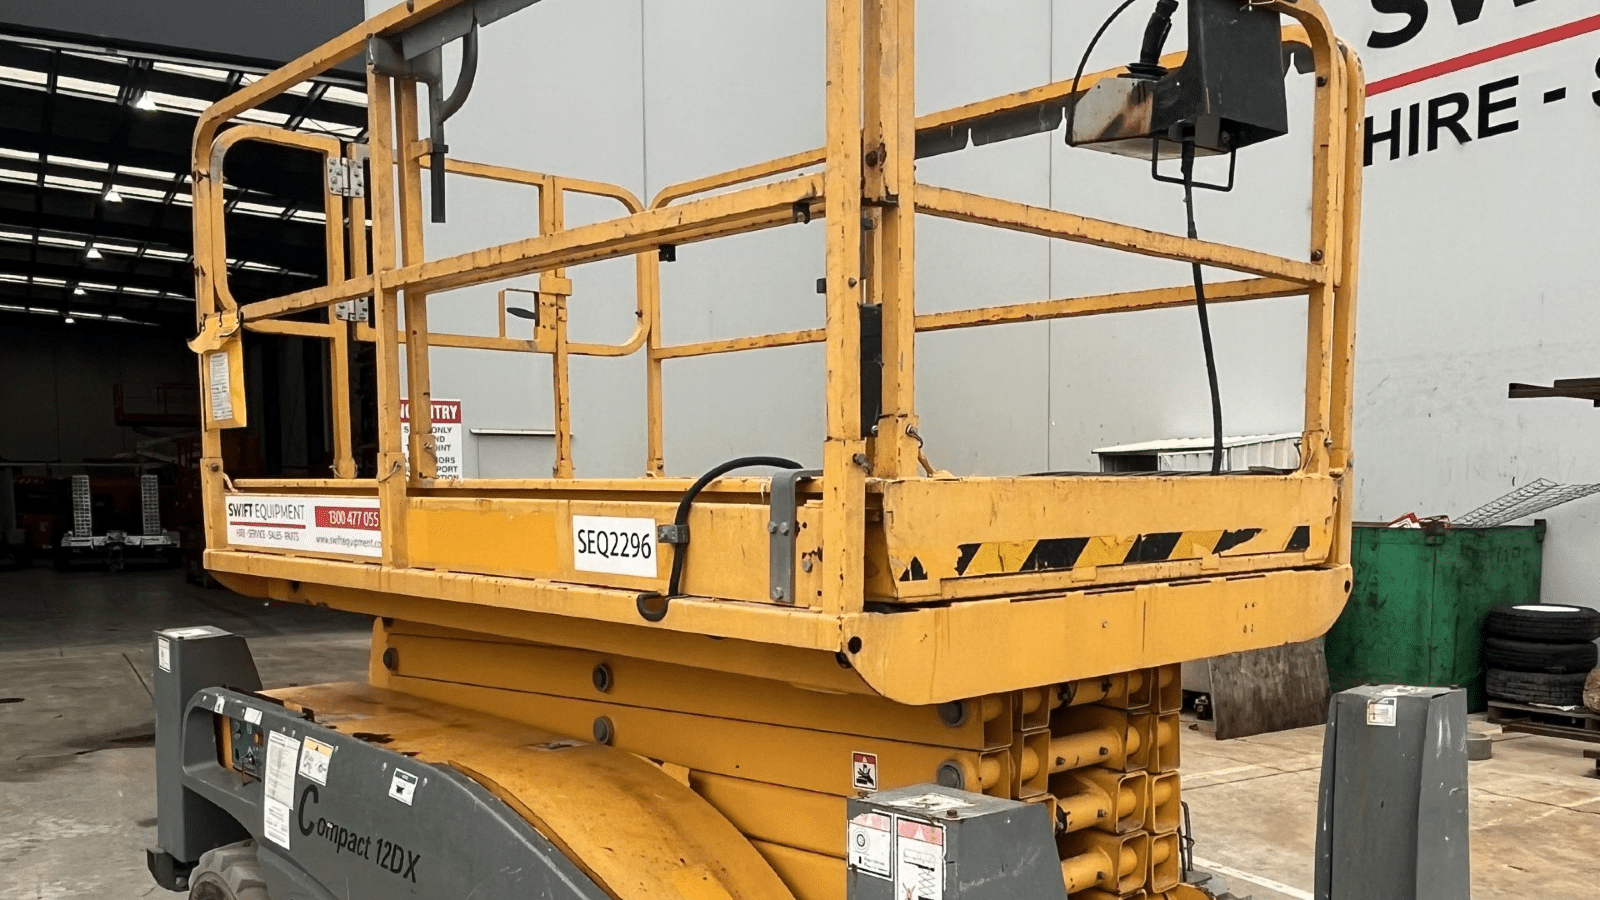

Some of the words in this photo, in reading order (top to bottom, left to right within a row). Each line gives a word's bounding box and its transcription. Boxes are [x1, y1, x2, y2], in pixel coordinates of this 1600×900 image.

[1363, 75, 1519, 167] HIRE
[431, 404, 458, 420] TRY
[431, 426, 452, 434] ONLY
[228, 503, 253, 517] SWIFT
[255, 503, 305, 521] EQUIPMENT
[328, 510, 345, 525] 1300
[346, 510, 361, 526] 477
[363, 511, 379, 527] 055
[577, 528, 652, 559] SEQ2296
[298, 784, 372, 860] Compact
[376, 838, 421, 884] 12DX
